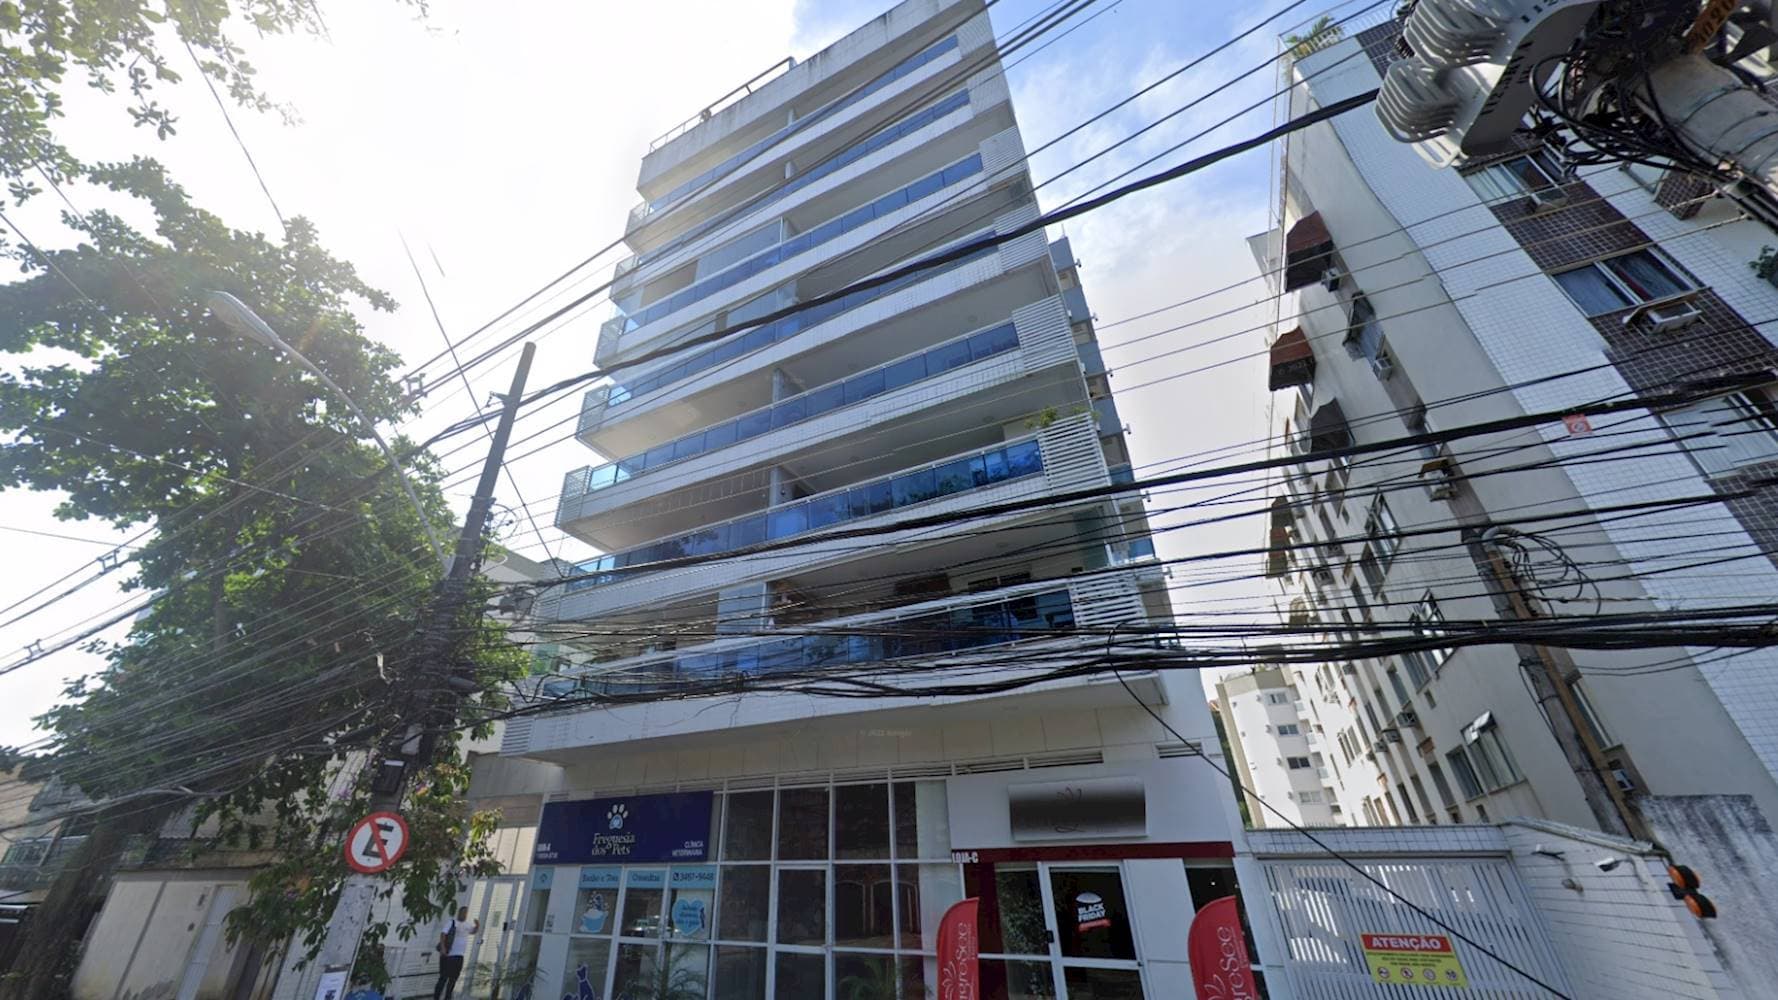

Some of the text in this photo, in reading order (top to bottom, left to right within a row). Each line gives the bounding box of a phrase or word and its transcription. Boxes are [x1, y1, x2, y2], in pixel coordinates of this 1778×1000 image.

[361, 823, 394, 859] E
[592, 832, 636, 848] Freguesia
[591, 843, 631, 856] dos Pets
[1078, 903, 1104, 914] BLACK
[1078, 910, 1106, 922] FRIDAY
[1372, 936, 1441, 951] ATENÇÃO
